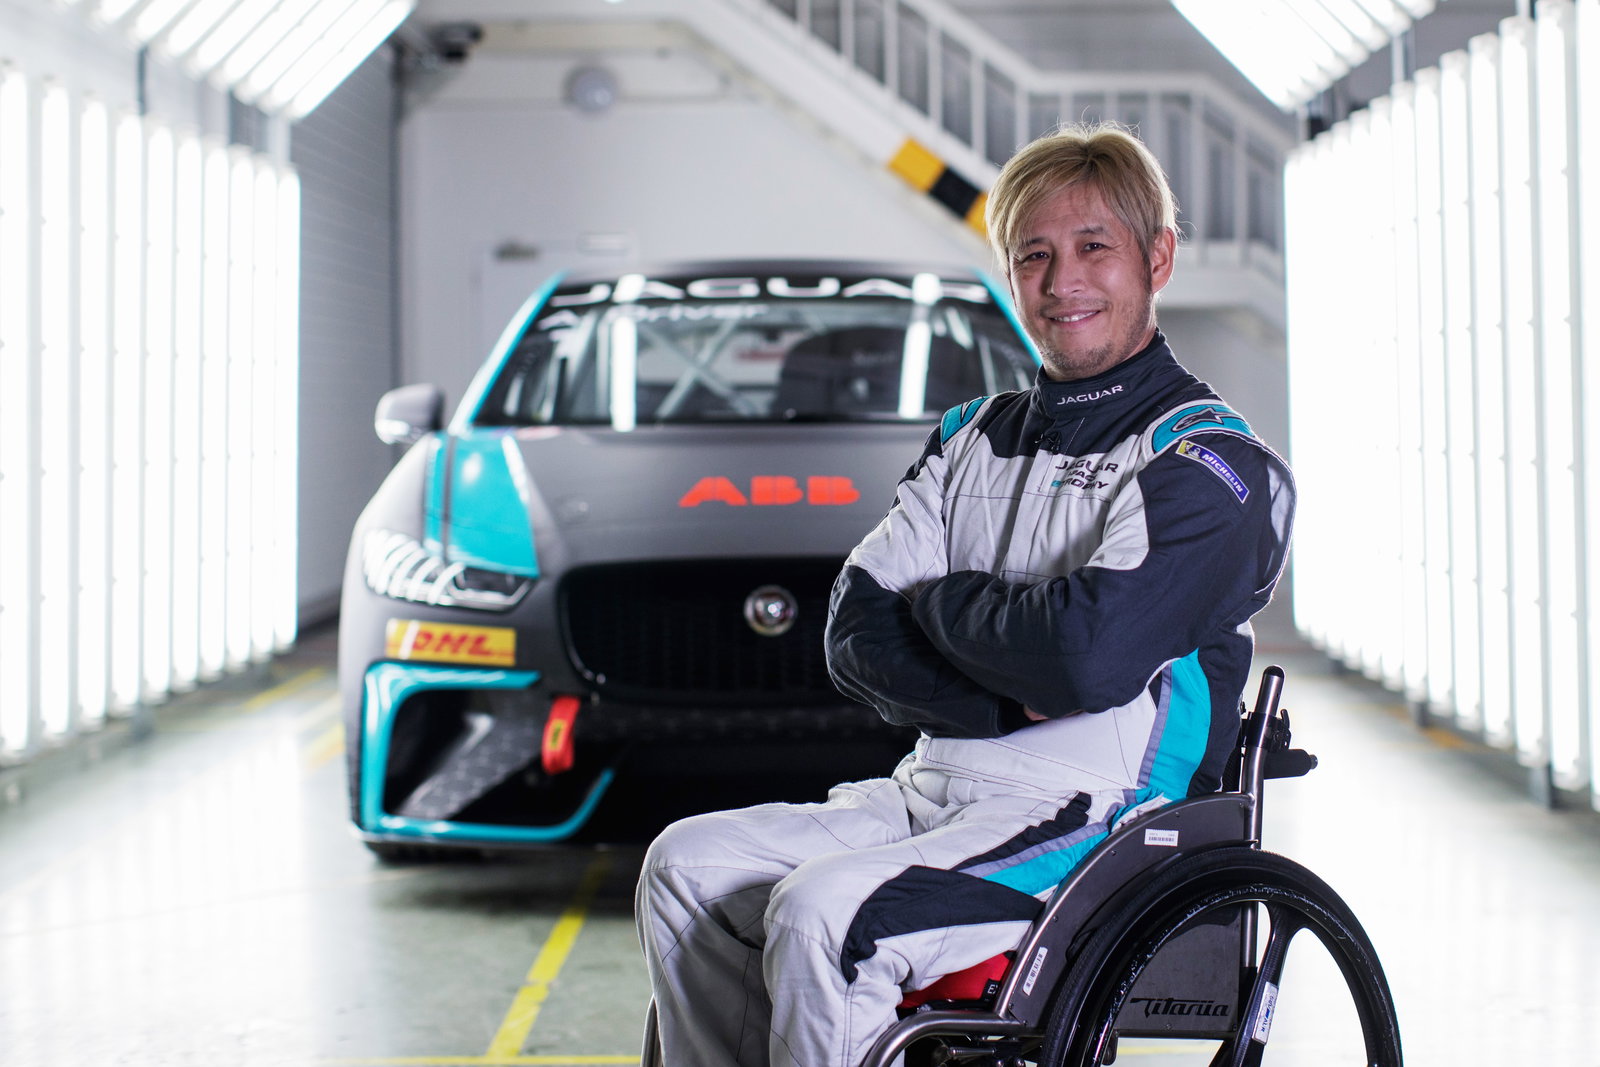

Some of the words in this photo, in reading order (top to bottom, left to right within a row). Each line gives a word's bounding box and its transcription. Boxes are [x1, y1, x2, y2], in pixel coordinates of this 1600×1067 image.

[1056, 384, 1124, 405] JAGUAR
[1201, 453, 1243, 493] MICHELIN
[678, 474, 861, 507] ABB
[411, 630, 493, 657] DHL
